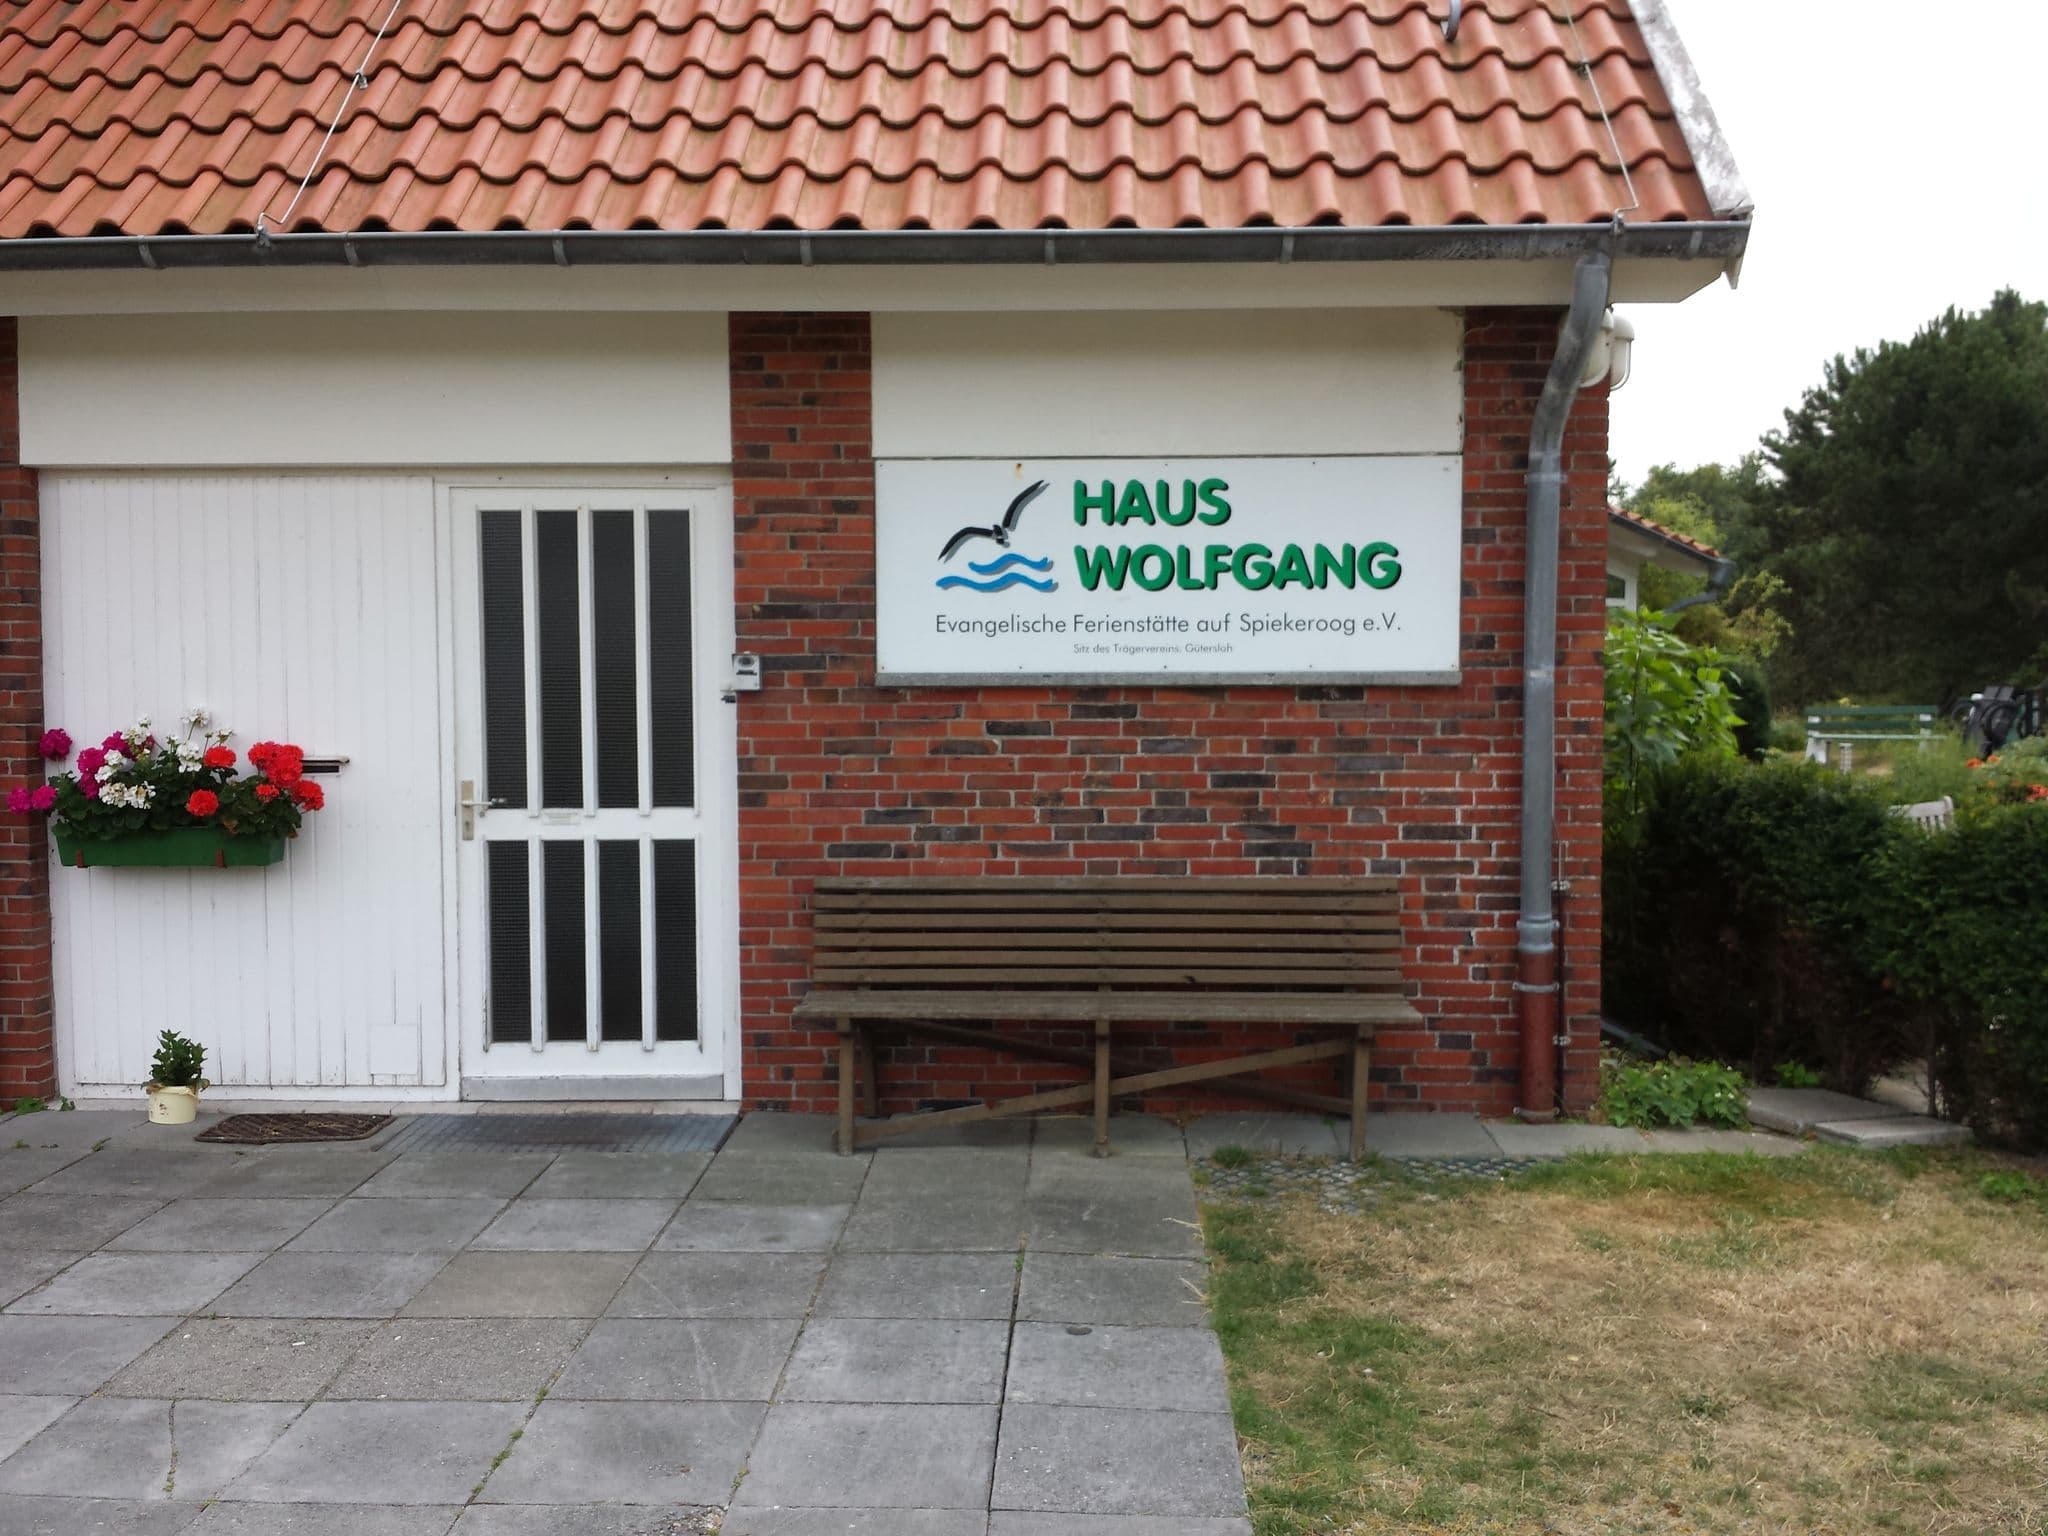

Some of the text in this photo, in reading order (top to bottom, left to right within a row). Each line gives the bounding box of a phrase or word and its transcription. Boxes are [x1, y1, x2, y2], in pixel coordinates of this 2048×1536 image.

[1073, 478, 1232, 528] HAUS
[1073, 541, 1403, 593] WOLFGANG
[935, 612, 1401, 638] Evangelische Ferienstätte auf Spiekeroog e.V.
[1073, 643, 1090, 655] Sitz
[1092, 643, 1110, 654] des
[1184, 642, 1233, 655] Gütersloh
